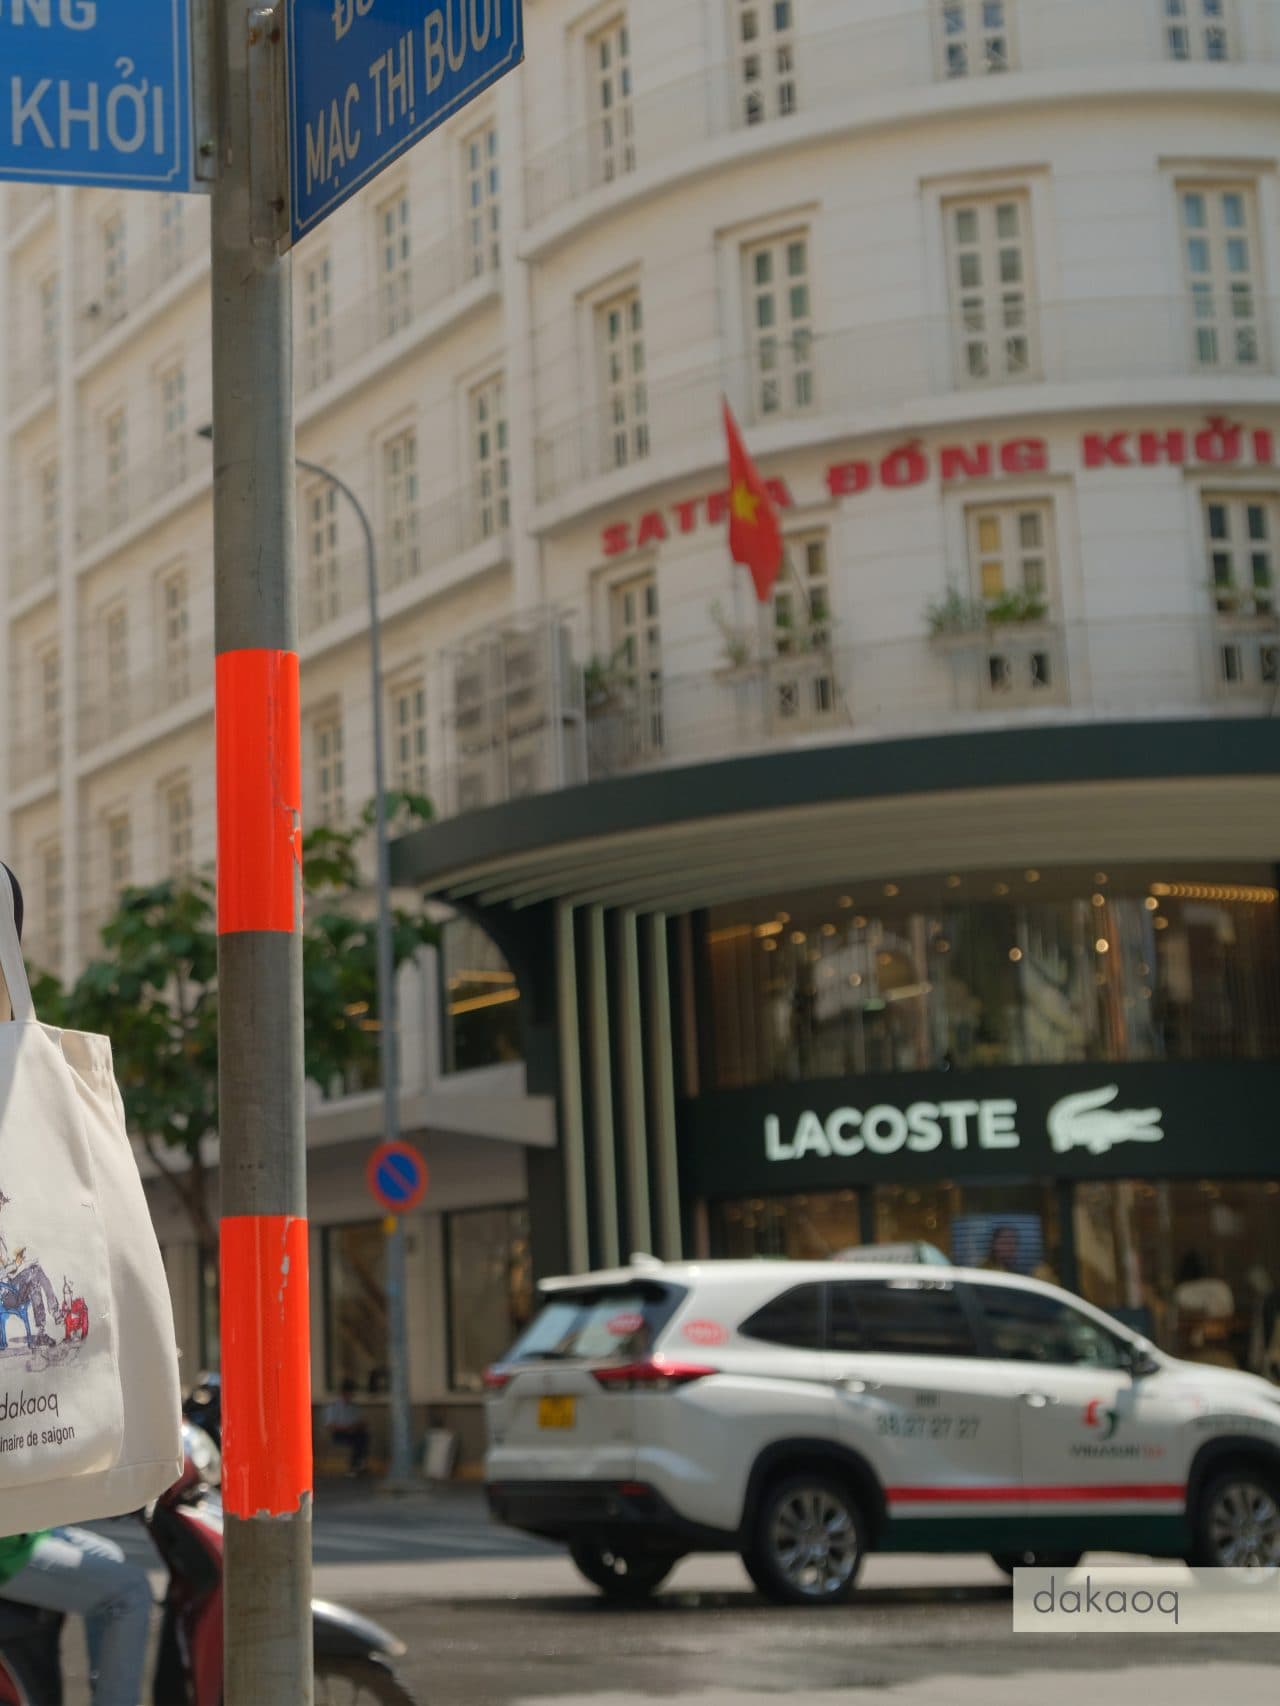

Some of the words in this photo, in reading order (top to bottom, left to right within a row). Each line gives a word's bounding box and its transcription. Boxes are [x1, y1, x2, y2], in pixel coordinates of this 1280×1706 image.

[11, 56, 165, 155] KHỞI
[305, 82, 361, 196] MẠC
[368, 30, 416, 136] THỊ
[764, 1099, 1020, 1161] LACOSTE
[26, 1430, 38, 1447] de
[41, 1426, 75, 1445] saigon
